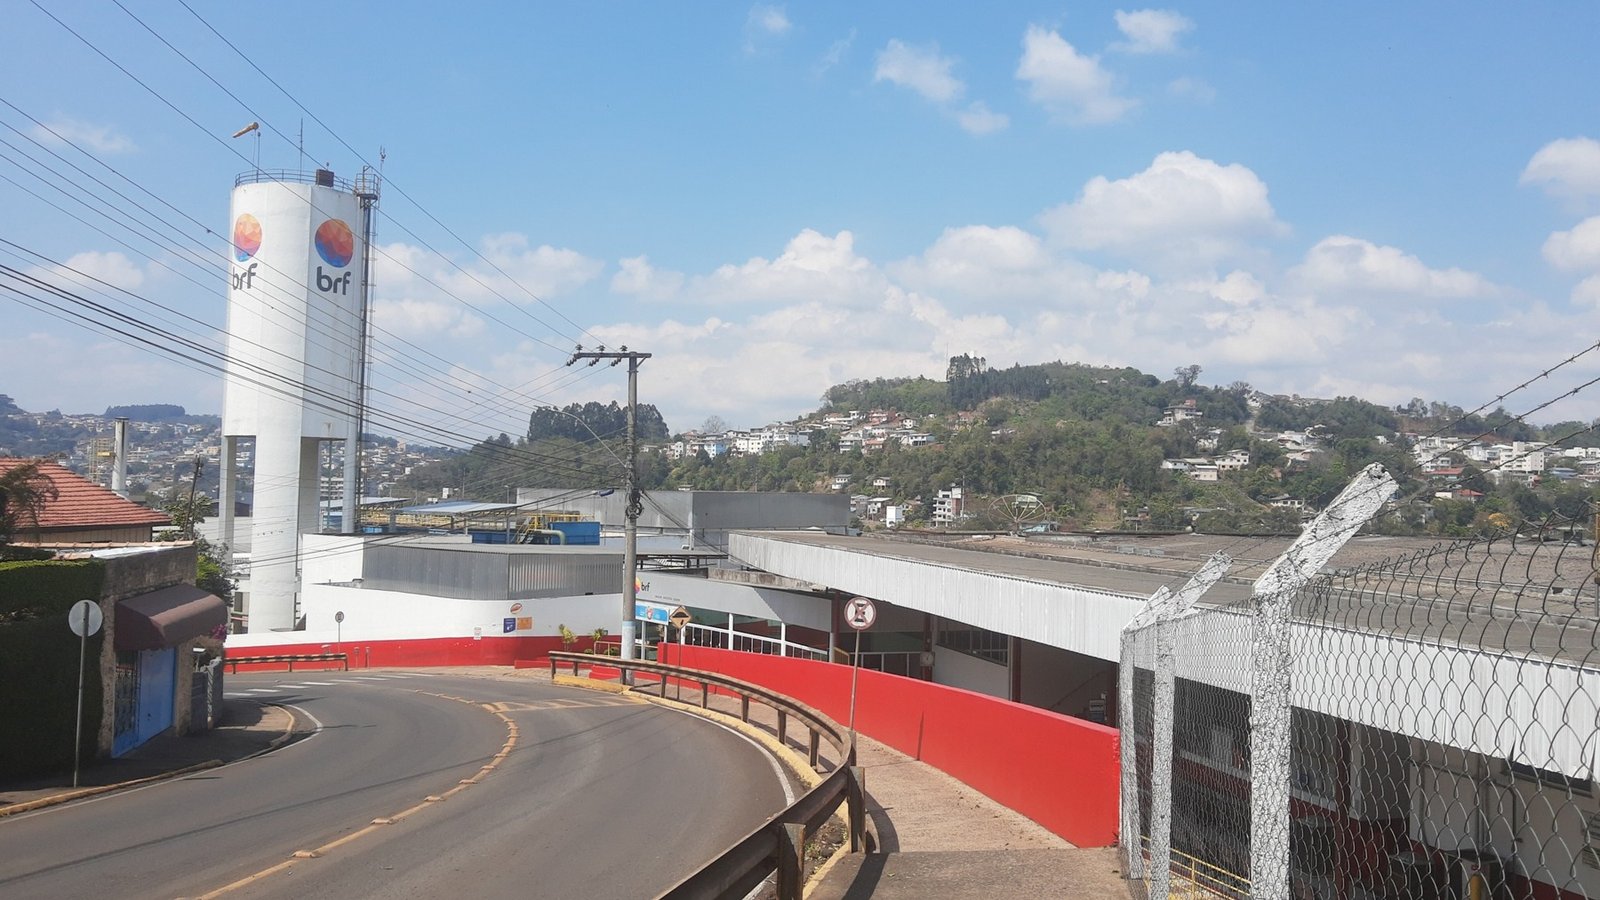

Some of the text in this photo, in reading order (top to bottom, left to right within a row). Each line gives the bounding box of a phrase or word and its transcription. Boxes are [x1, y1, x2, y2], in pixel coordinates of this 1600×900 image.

[232, 263, 258, 290] brf
[316, 266, 351, 295] brf
[641, 582, 650, 591] brf
